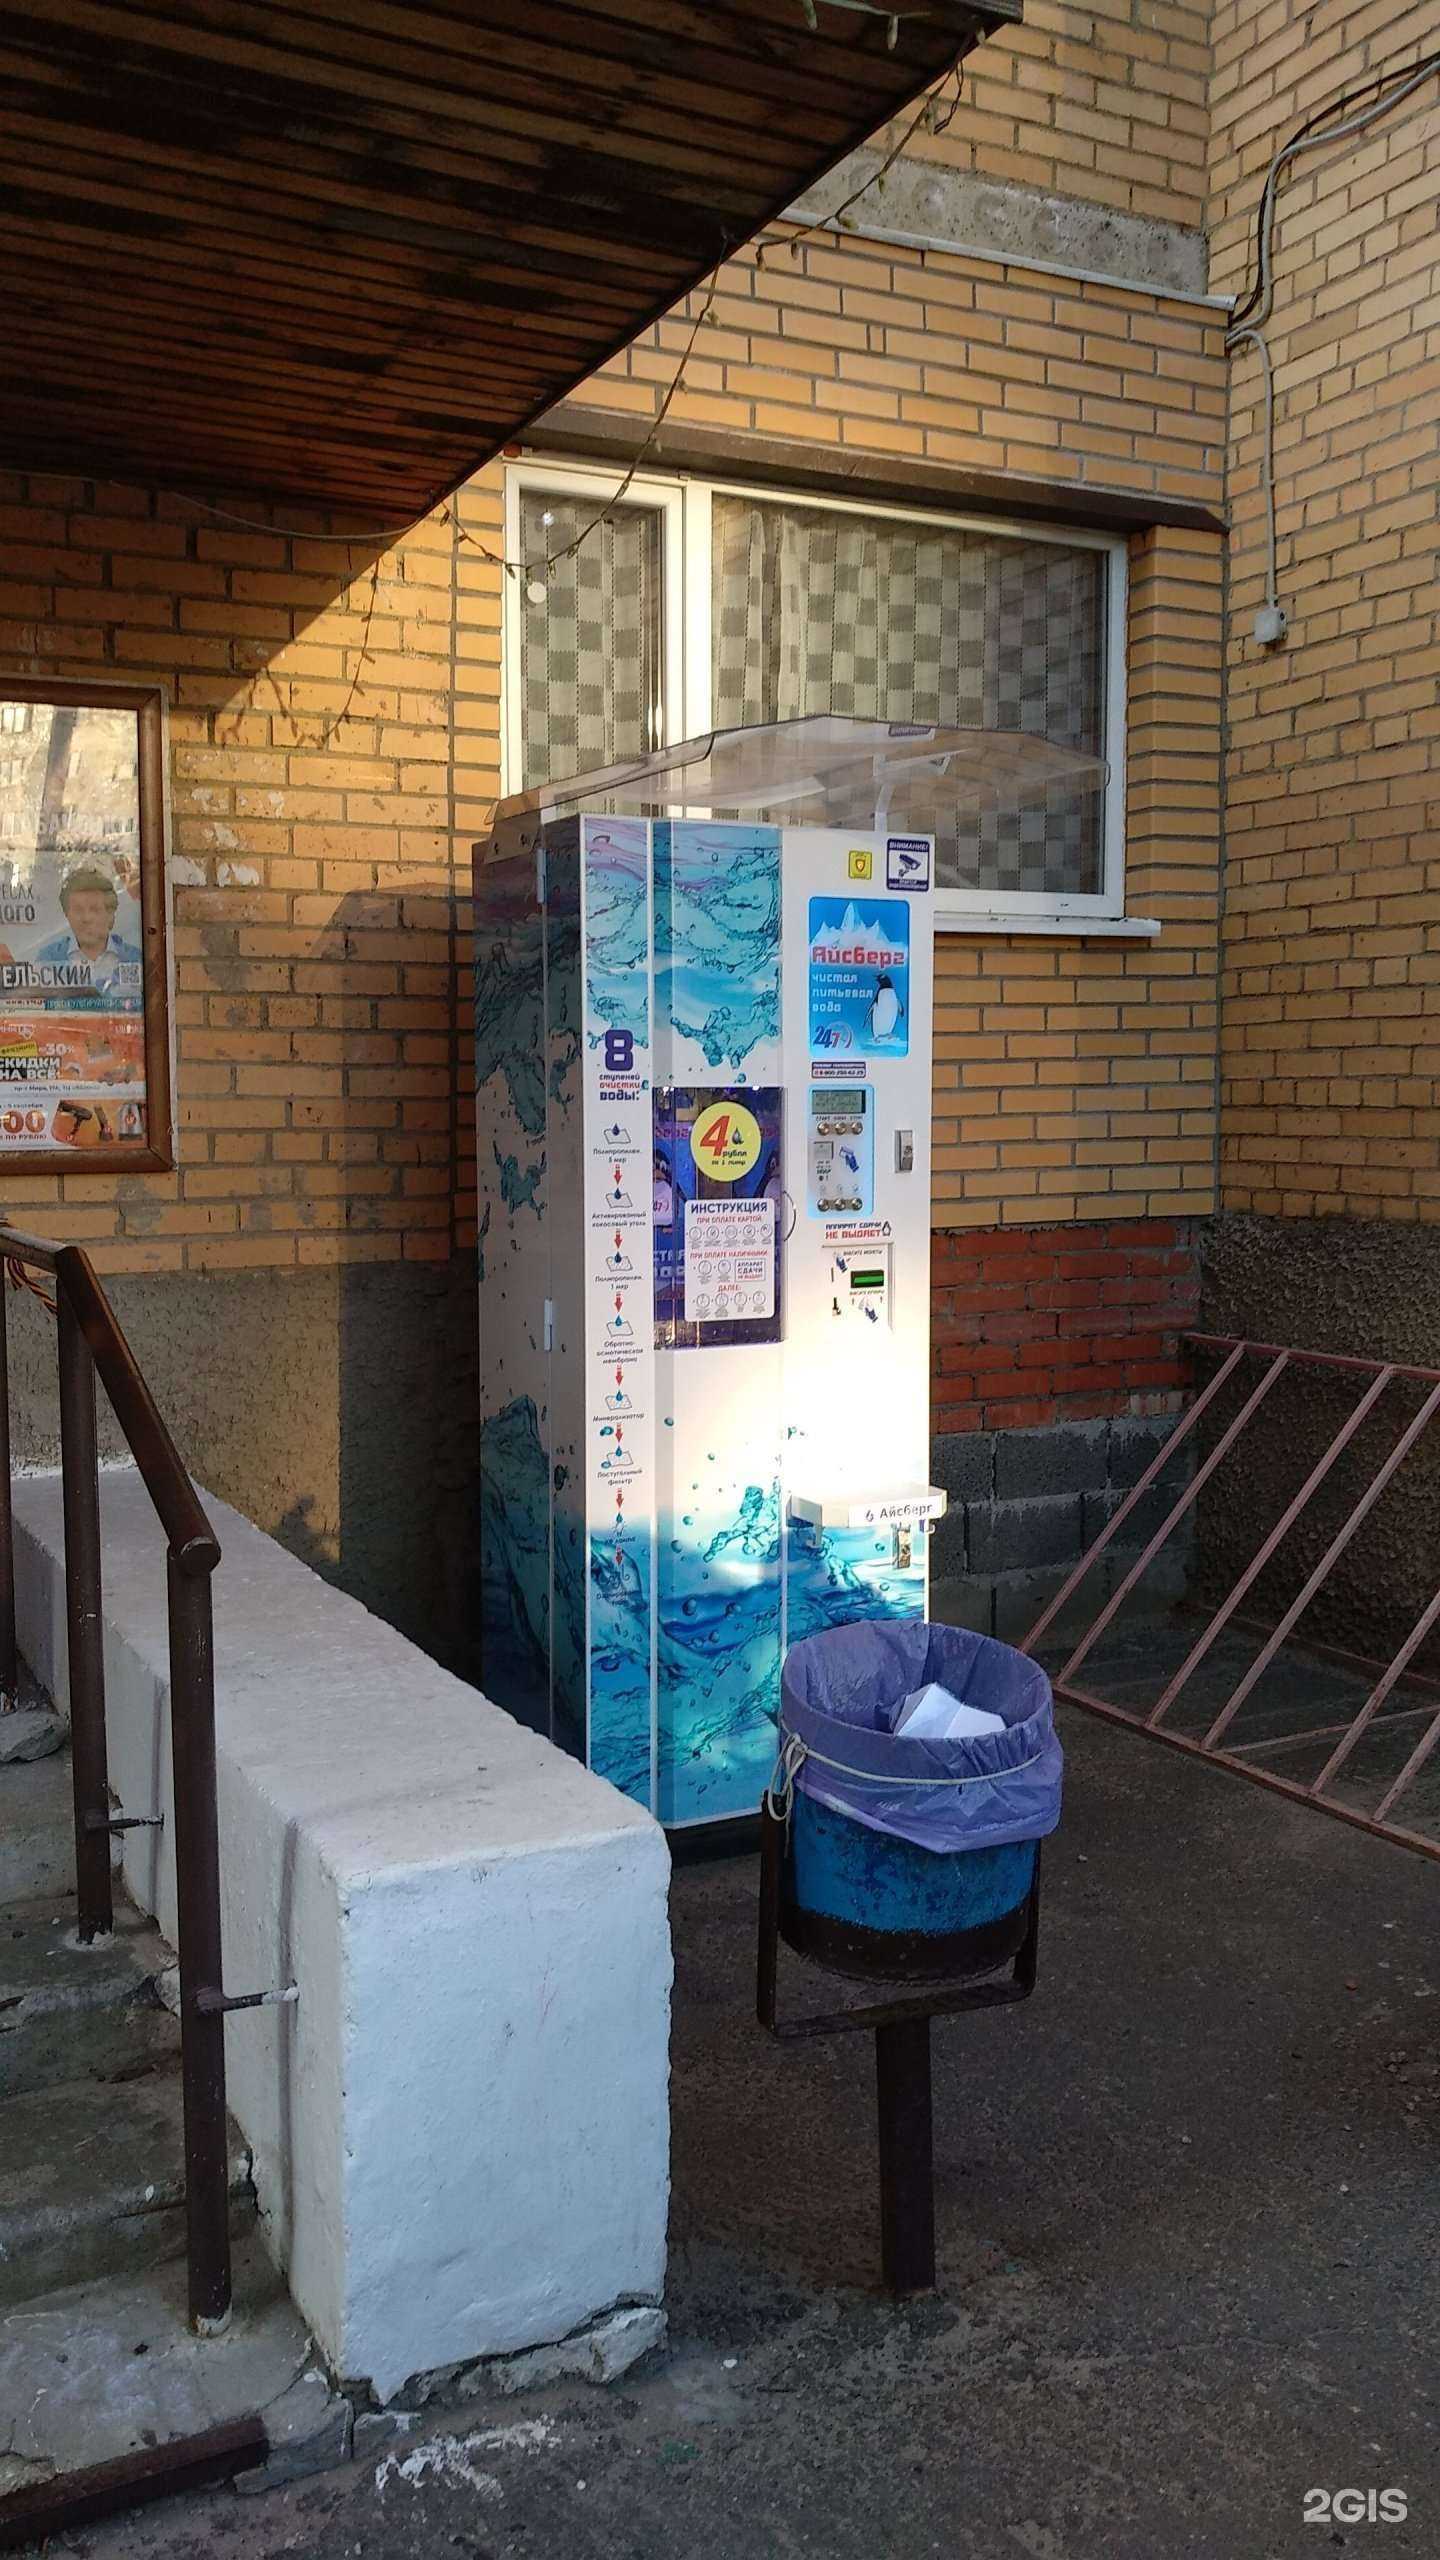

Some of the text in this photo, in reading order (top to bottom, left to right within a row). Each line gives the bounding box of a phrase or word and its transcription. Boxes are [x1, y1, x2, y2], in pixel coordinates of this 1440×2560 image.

[812, 945, 905, 968] Айсберг
[812, 973, 858, 983] чистая
[812, 988, 874, 998] питьевая
[812, 1001, 841, 1013] вода
[605, 1029, 634, 1071] 8
[599, 1072, 640, 1081] ступеней
[600, 1089, 640, 1101] воды:
[699, 1115, 731, 1156] 4
[722, 1149, 747, 1158] рубля
[691, 1201, 768, 1214] ИНСТРУКЦИЯ
[711, 1216, 736, 1224] ОПЛАТЕ
[825, 1221, 882, 1230] АППАРАТ СДАЧИ
[825, 1229, 881, 1239] НЕ ВЫДАЕТ
[879, 1504, 933, 1519] Айсберг
